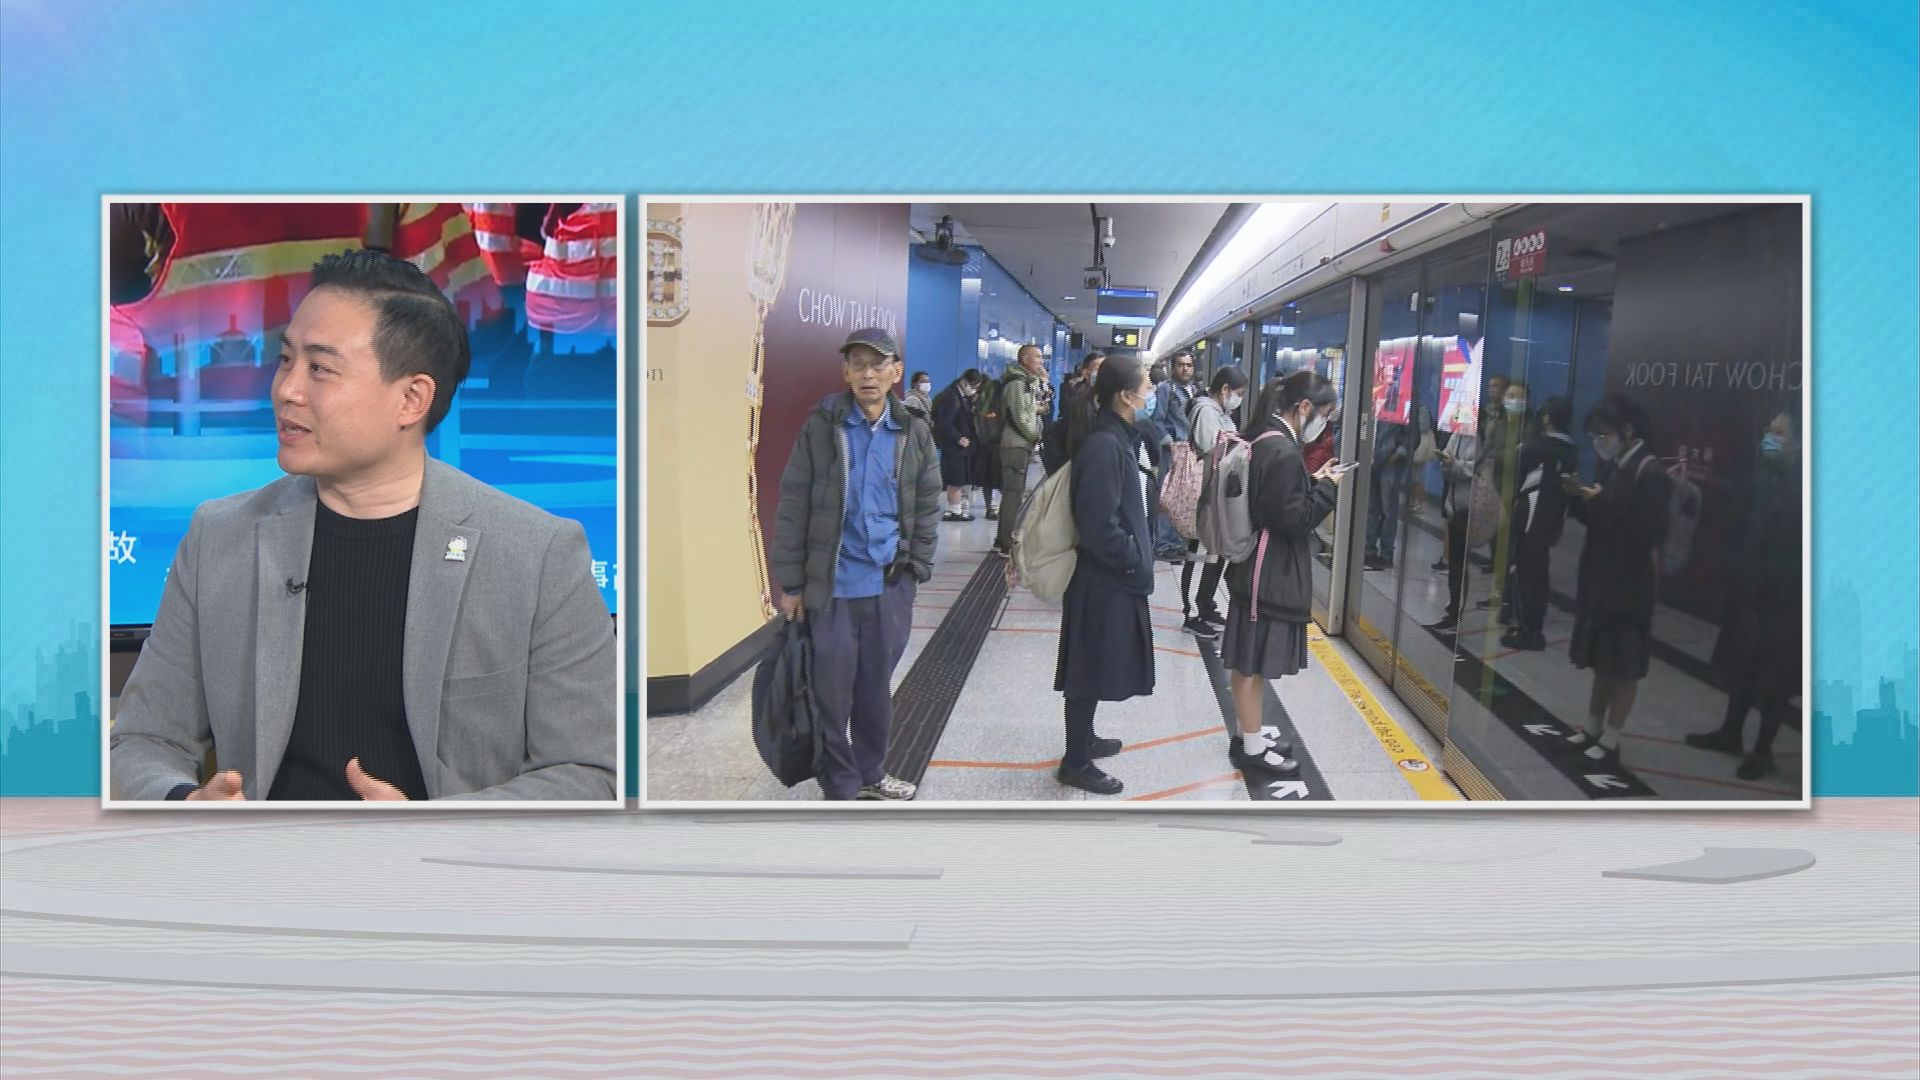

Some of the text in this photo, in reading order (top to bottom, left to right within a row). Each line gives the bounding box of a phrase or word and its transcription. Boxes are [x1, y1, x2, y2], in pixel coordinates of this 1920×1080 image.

[799, 287, 846, 328] CHOW
[849, 301, 867, 330] TAI
[647, 368, 663, 382] n
[591, 559, 617, 591] 事
